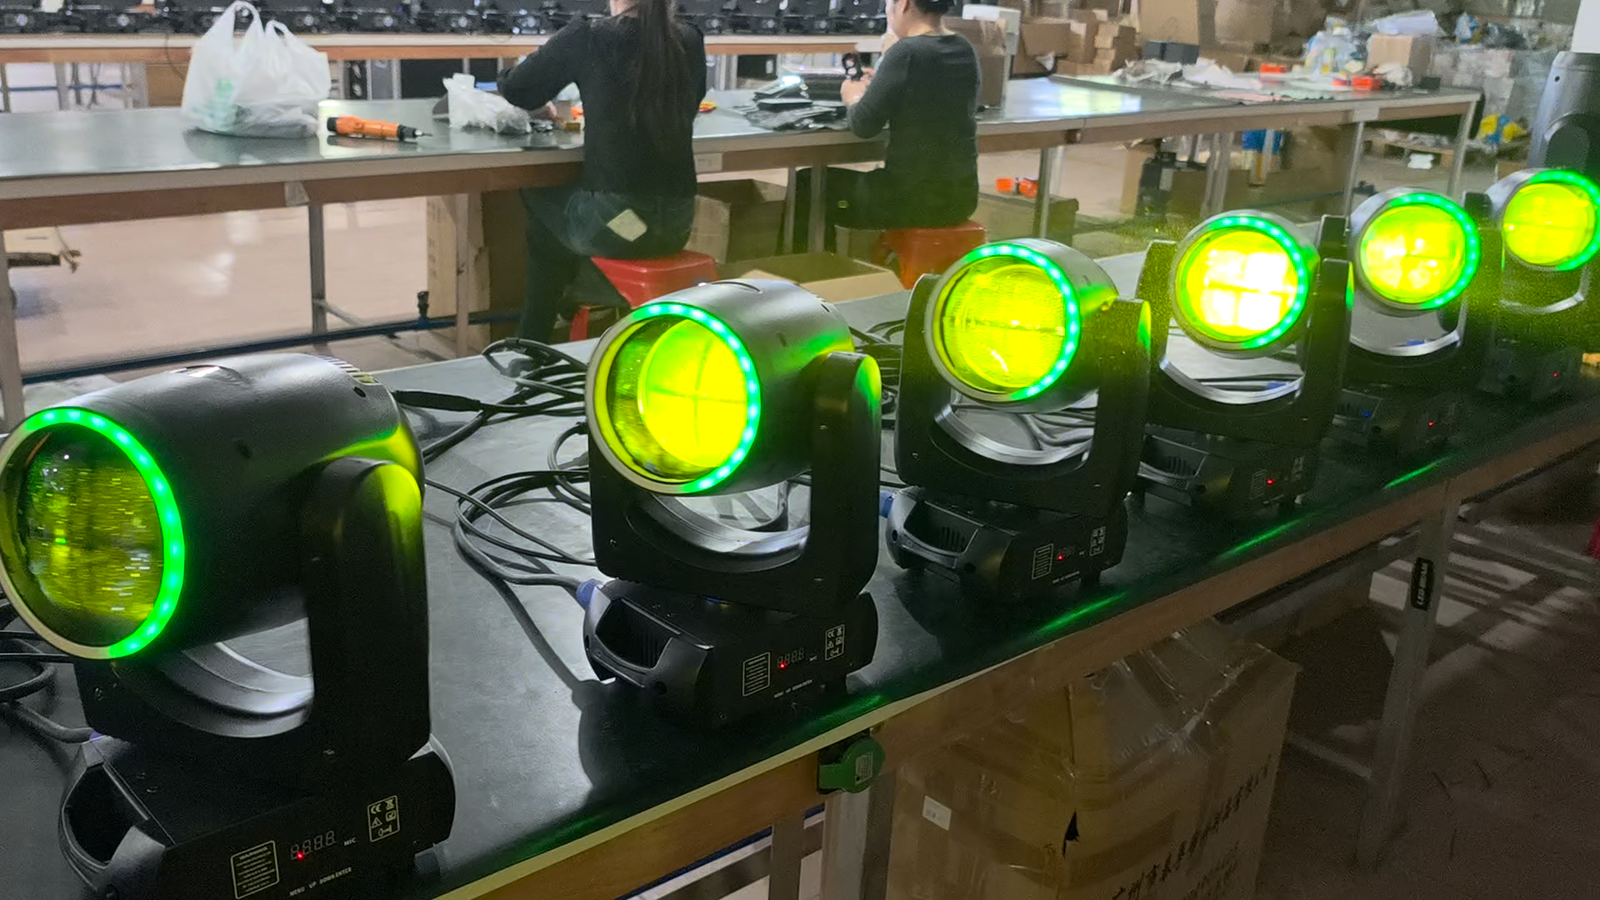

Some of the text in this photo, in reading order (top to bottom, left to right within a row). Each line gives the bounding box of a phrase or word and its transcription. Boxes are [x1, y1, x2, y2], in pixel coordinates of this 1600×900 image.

[343, 837, 357, 846] MIC
[289, 887, 306, 897] MENU
[308, 881, 317, 889] UP
[335, 866, 352, 878] ENTER
